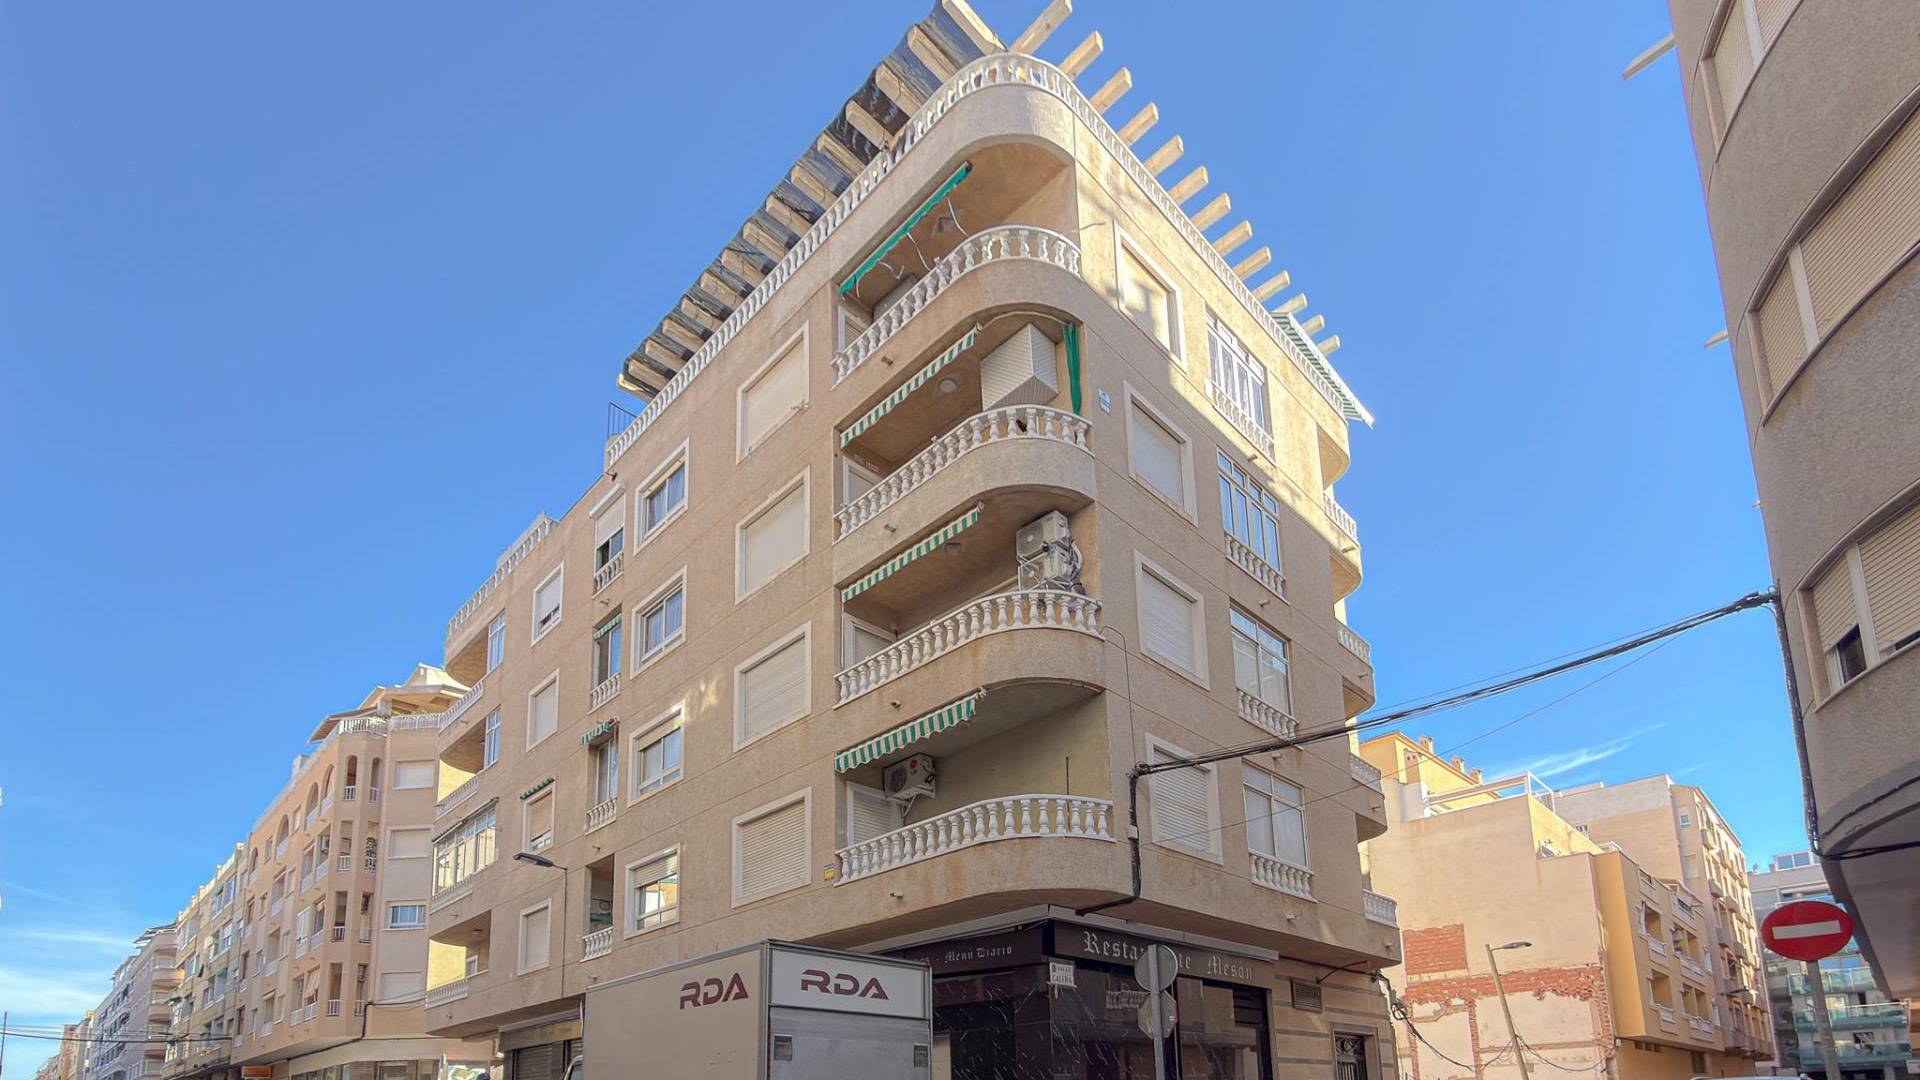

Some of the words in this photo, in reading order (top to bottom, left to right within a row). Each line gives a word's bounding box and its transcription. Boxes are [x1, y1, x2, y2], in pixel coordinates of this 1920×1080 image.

[976, 945, 1013, 958] Diario
[1082, 930, 1192, 969] Restate
[679, 972, 749, 1010] RDA
[801, 969, 889, 1000] RDA
